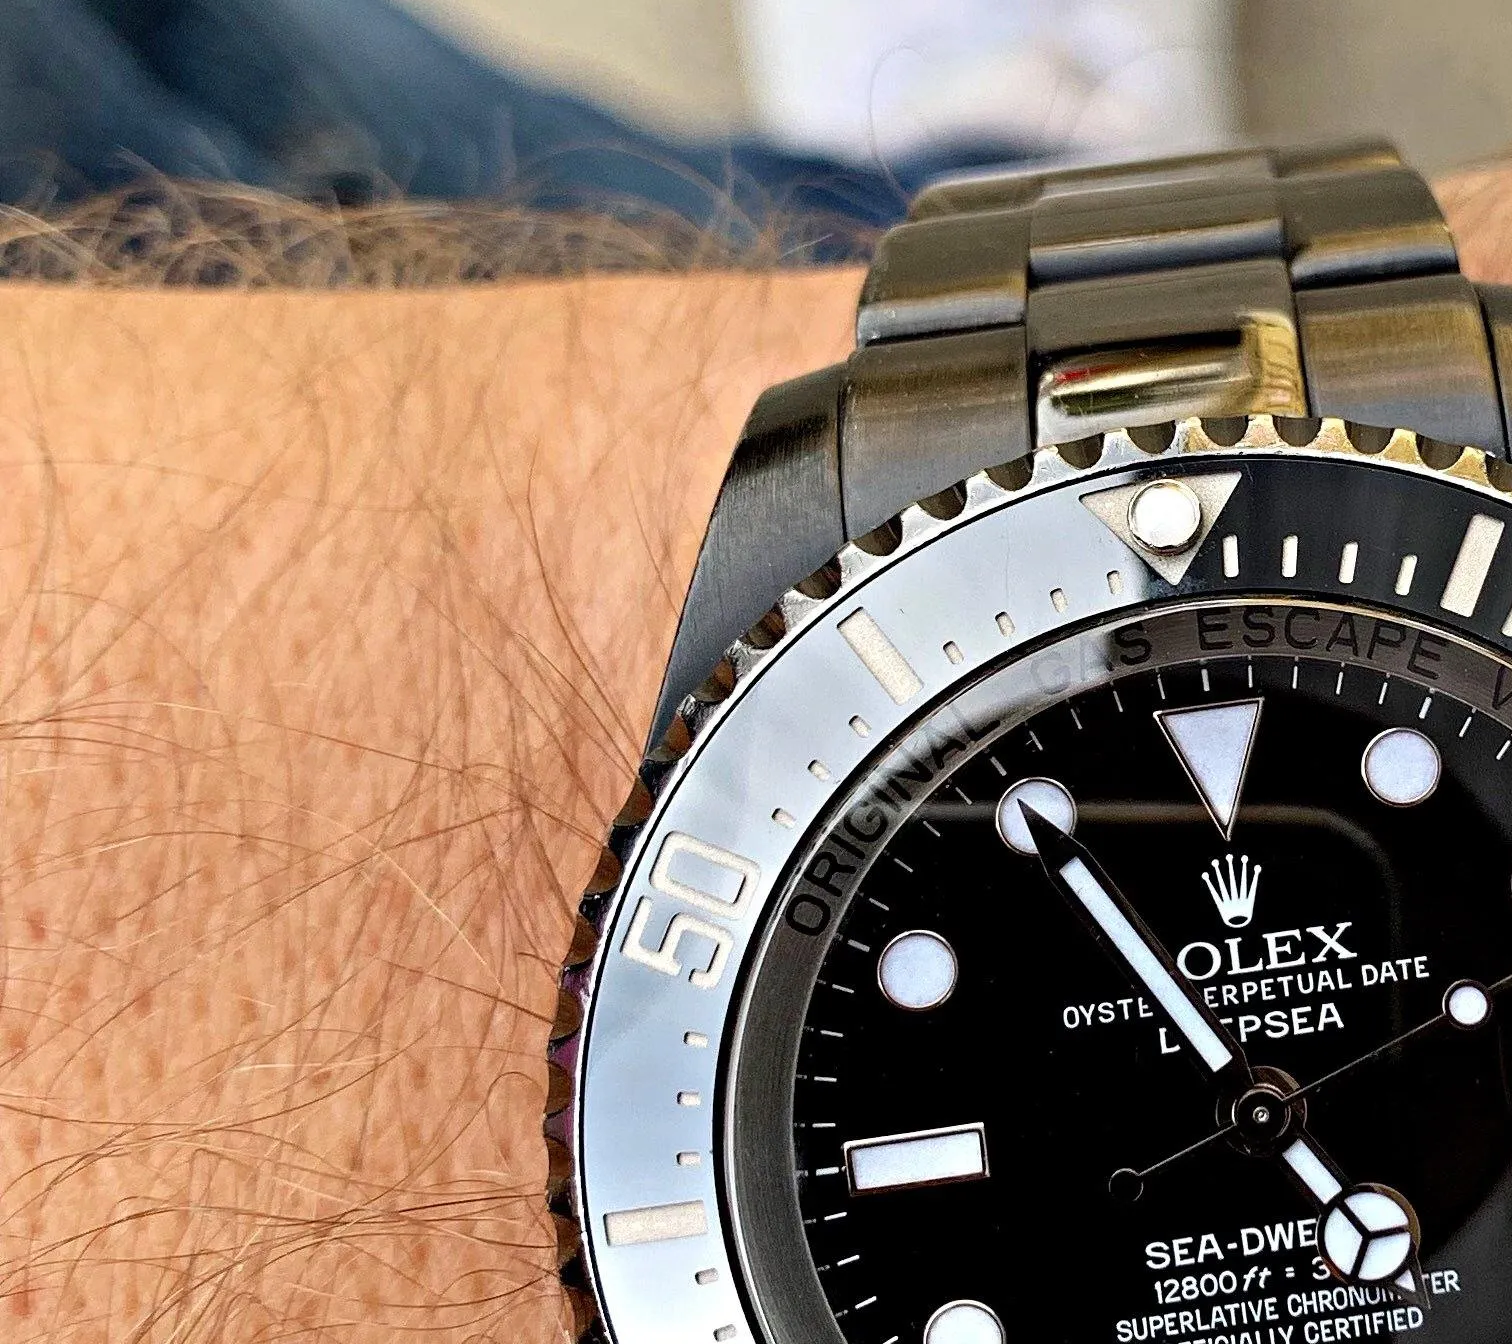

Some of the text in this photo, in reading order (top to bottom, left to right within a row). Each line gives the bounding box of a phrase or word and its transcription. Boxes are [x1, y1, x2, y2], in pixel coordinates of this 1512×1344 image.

[784, 702, 998, 938] ORIGINAL
[1030, 621, 1153, 696] GAS
[1199, 606, 1447, 681] ESCAPE
[621, 831, 761, 990] 50
[1176, 921, 1358, 981] OLEX
[1062, 955, 1430, 1029] OYSTE ERPETUAL DATE
[1145, 1218, 1318, 1270] SEA-DWE
[1116, 1269, 1461, 1343] SUPERLATIVE CHRONOER
[1304, 1307, 1424, 1344] CERTIFIED
